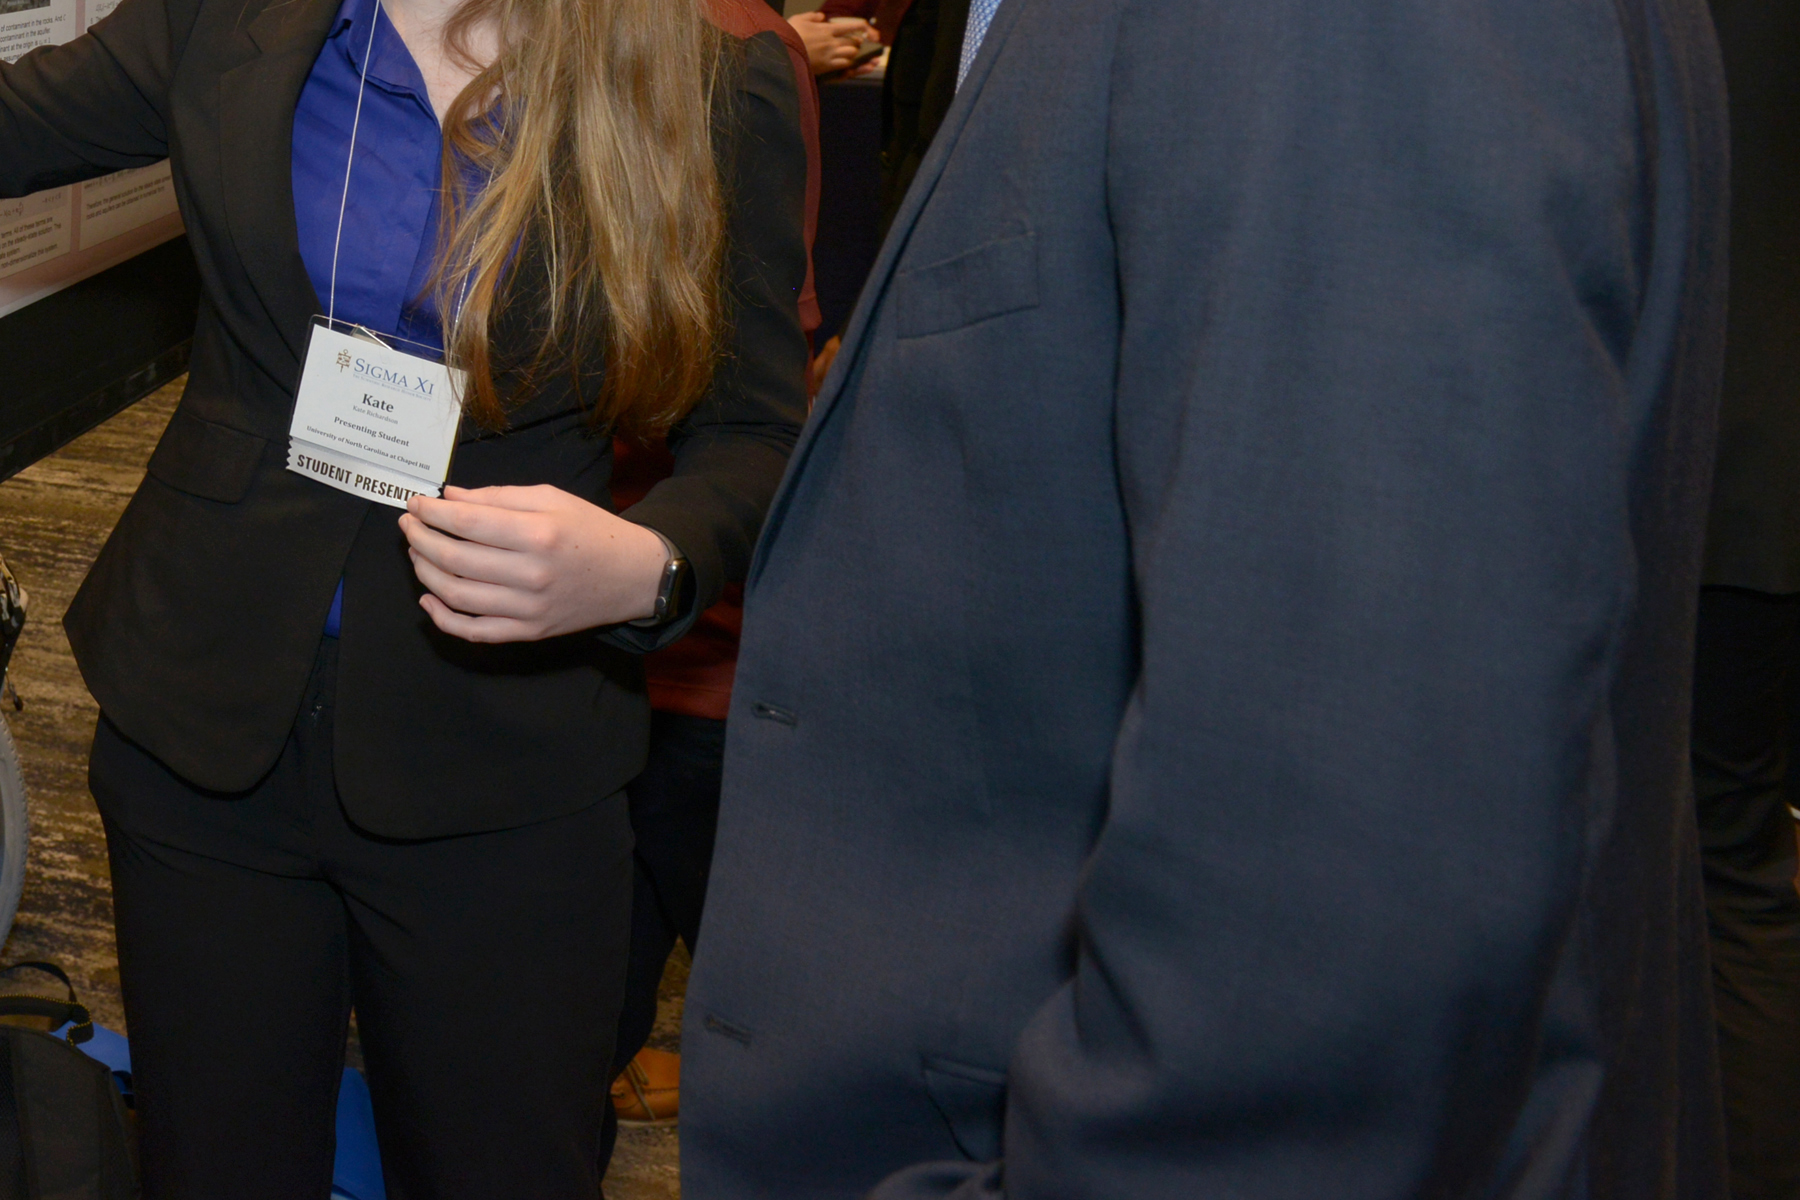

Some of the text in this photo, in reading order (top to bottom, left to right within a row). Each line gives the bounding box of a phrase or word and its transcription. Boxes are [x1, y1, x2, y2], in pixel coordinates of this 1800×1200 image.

[354, 358, 408, 388] SIGMA
[414, 376, 434, 395] XI
[362, 393, 394, 413] Kate
[334, 416, 409, 447] Presenting Student
[297, 454, 426, 502] STUDENT PRESENT
